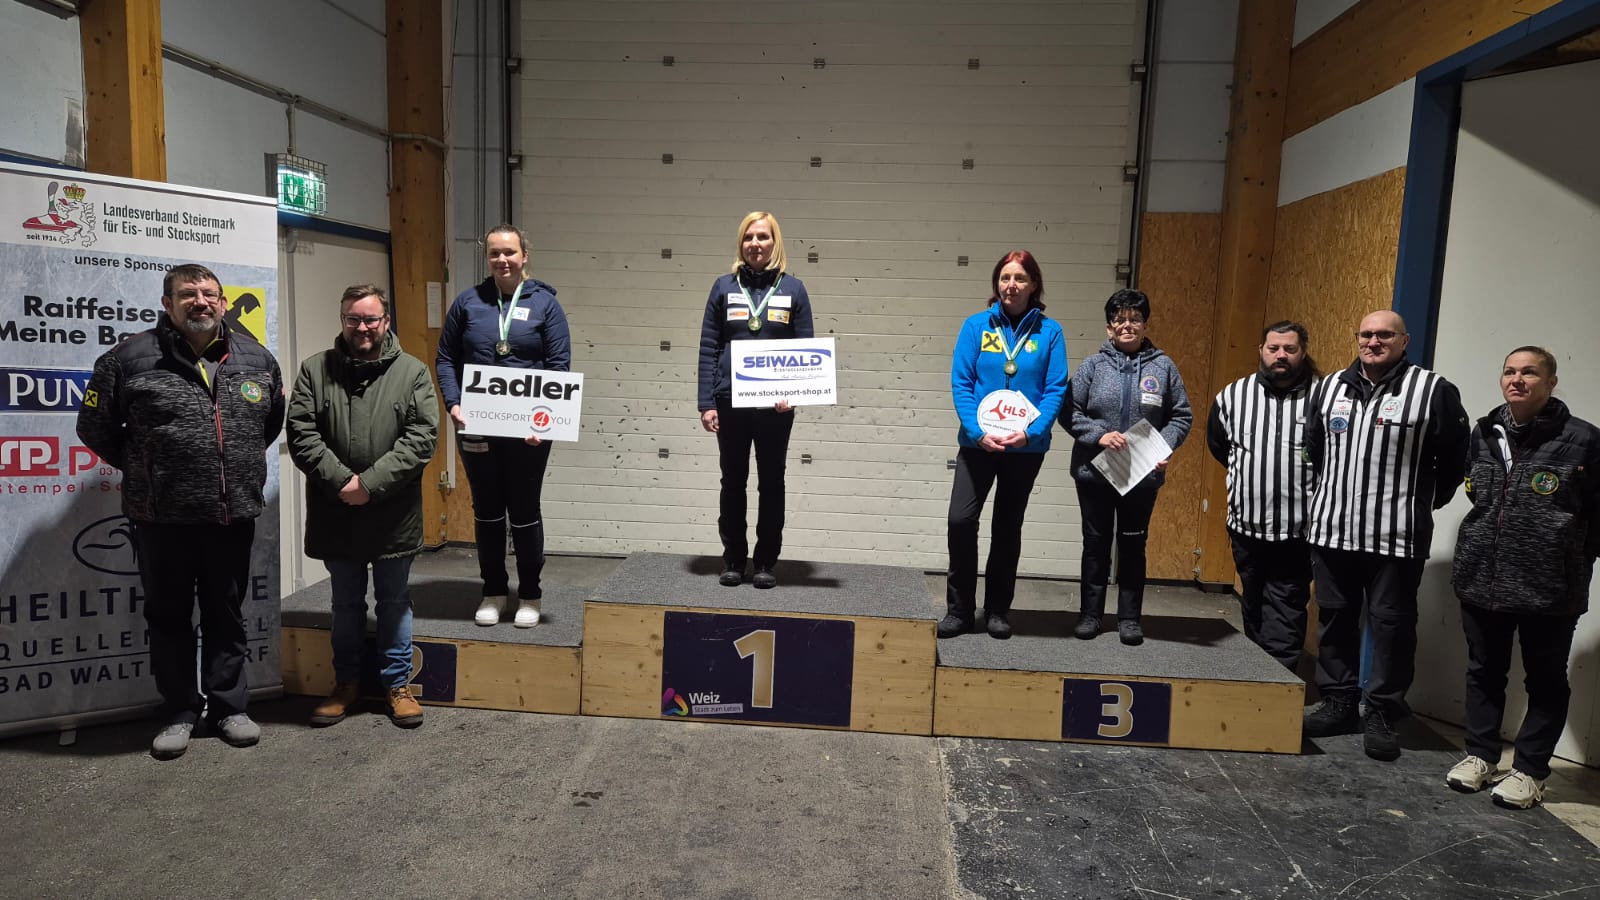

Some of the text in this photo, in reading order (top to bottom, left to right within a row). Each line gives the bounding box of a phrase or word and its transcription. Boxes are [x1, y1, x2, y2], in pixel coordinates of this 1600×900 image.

[103, 202, 235, 230] Landesverband Steiermark
[103, 219, 220, 245] für Eis- und Stocksport
[74, 255, 120, 267] unsere
[0, 320, 87, 345] Meine
[743, 355, 823, 369] SEIWALD
[465, 370, 580, 401] Ladler
[737, 388, 832, 398] www.stocksport-shop.at
[469, 410, 531, 423] STOCKSPORT
[552, 416, 571, 426] YOU
[1003, 404, 1026, 418] HLS
[733, 629, 776, 709] 1
[688, 691, 721, 705] Weiz
[1097, 682, 1134, 738] 3
